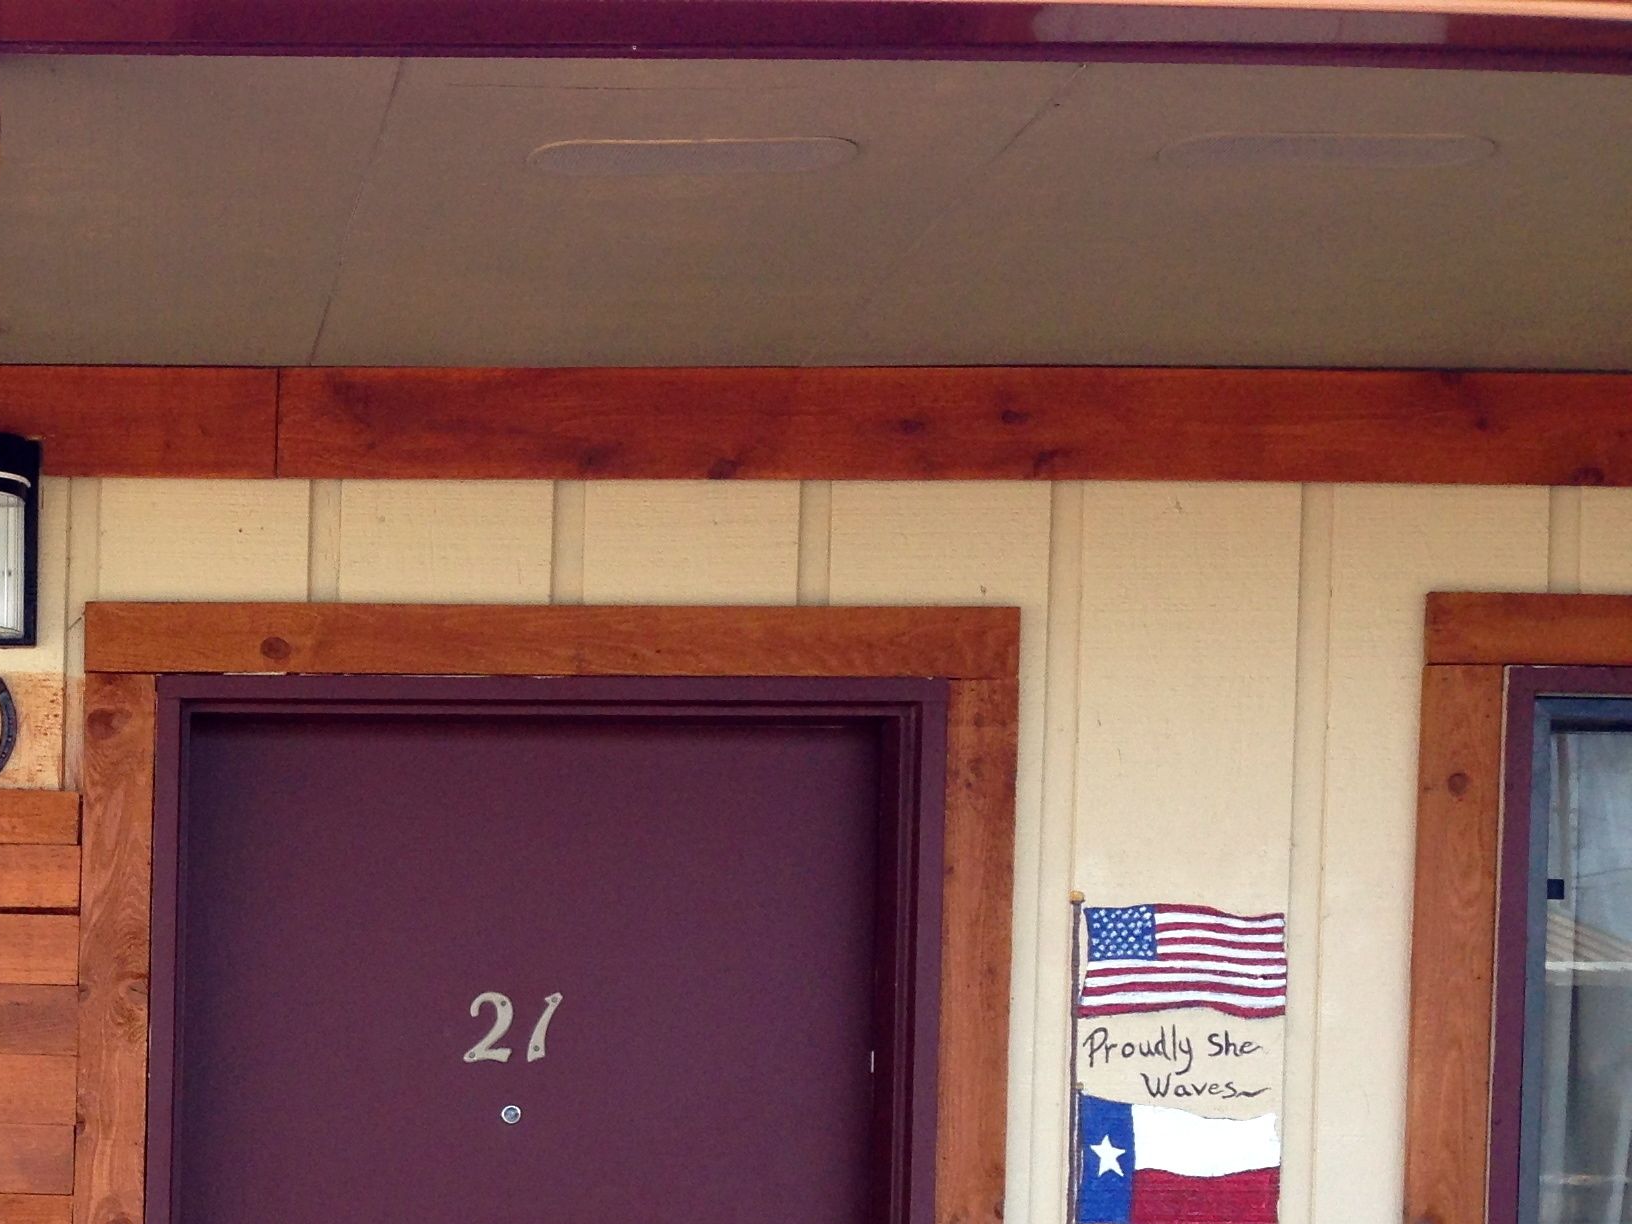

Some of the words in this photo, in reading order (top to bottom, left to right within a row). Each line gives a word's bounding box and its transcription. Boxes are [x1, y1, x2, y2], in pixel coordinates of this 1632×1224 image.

[463, 991, 564, 1063] 21
[1082, 1023, 1194, 1076] Proudly
[1207, 1029, 1264, 1058] She
